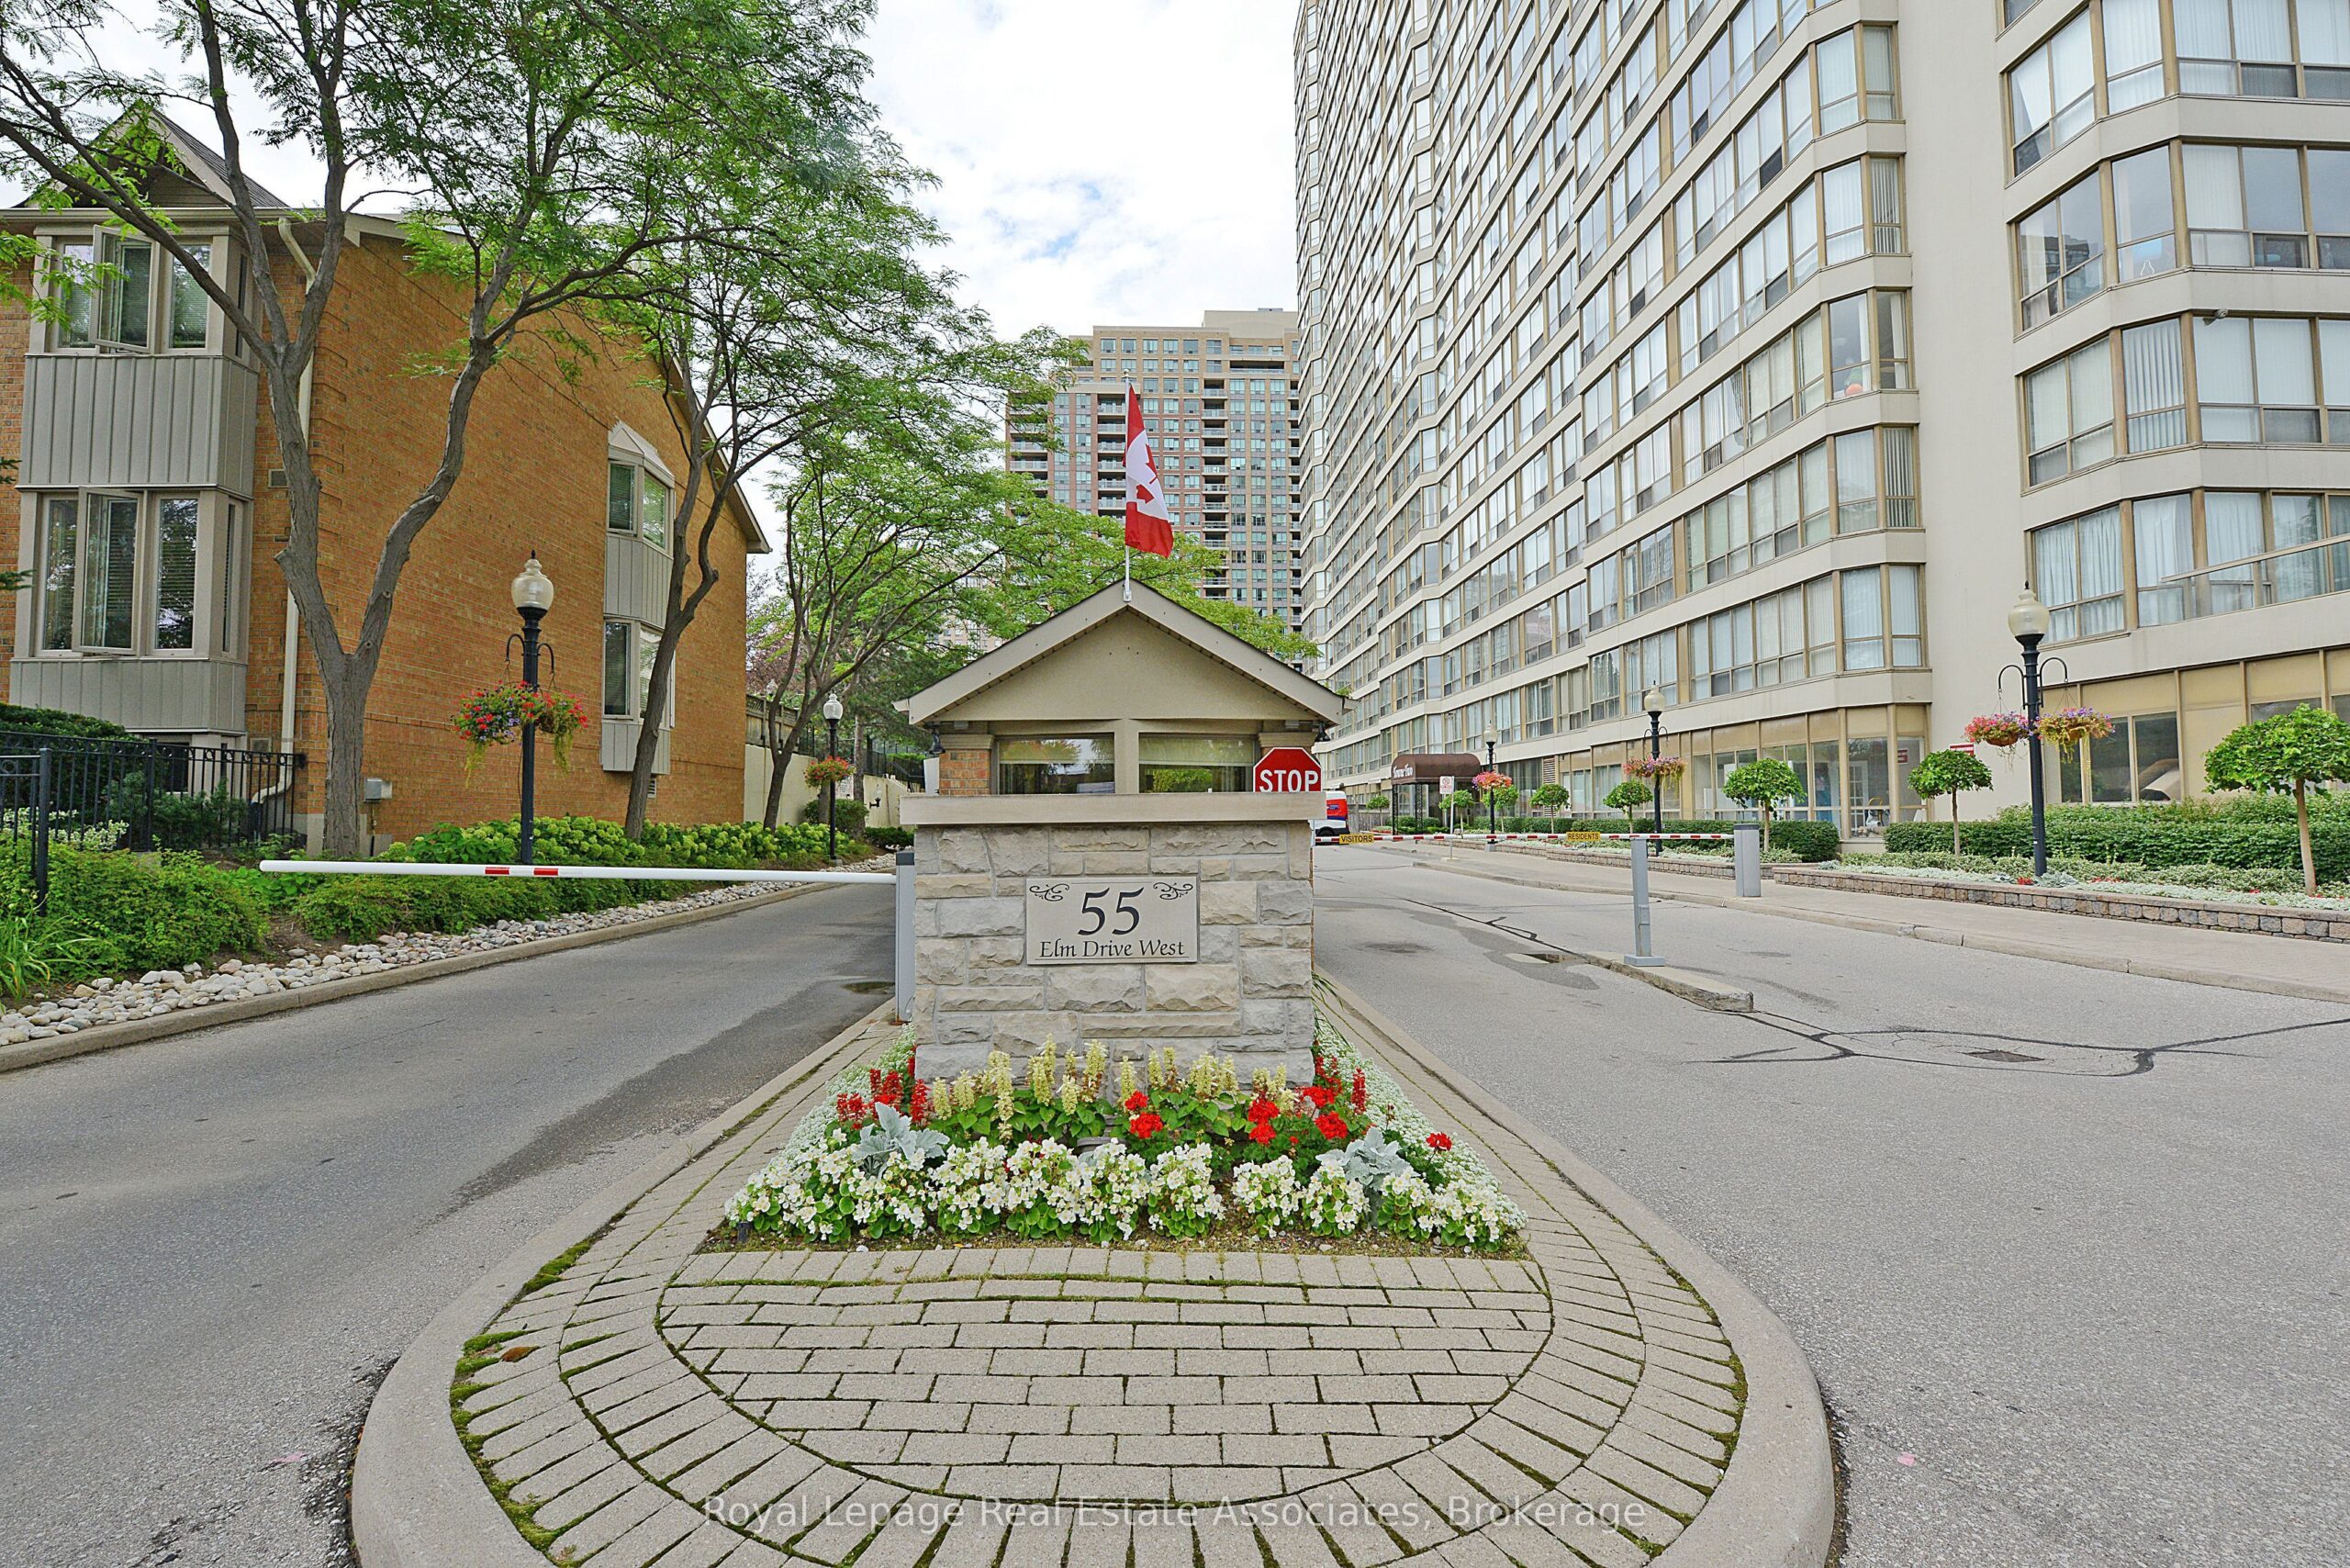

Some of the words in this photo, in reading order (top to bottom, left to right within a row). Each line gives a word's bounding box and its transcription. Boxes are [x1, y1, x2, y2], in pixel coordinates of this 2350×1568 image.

[1259, 768, 1319, 792] STOP
[1078, 887, 1144, 935] 55
[1039, 938, 1077, 958] Elm
[1081, 940, 1133, 957] Drive
[1139, 939, 1185, 956] West
